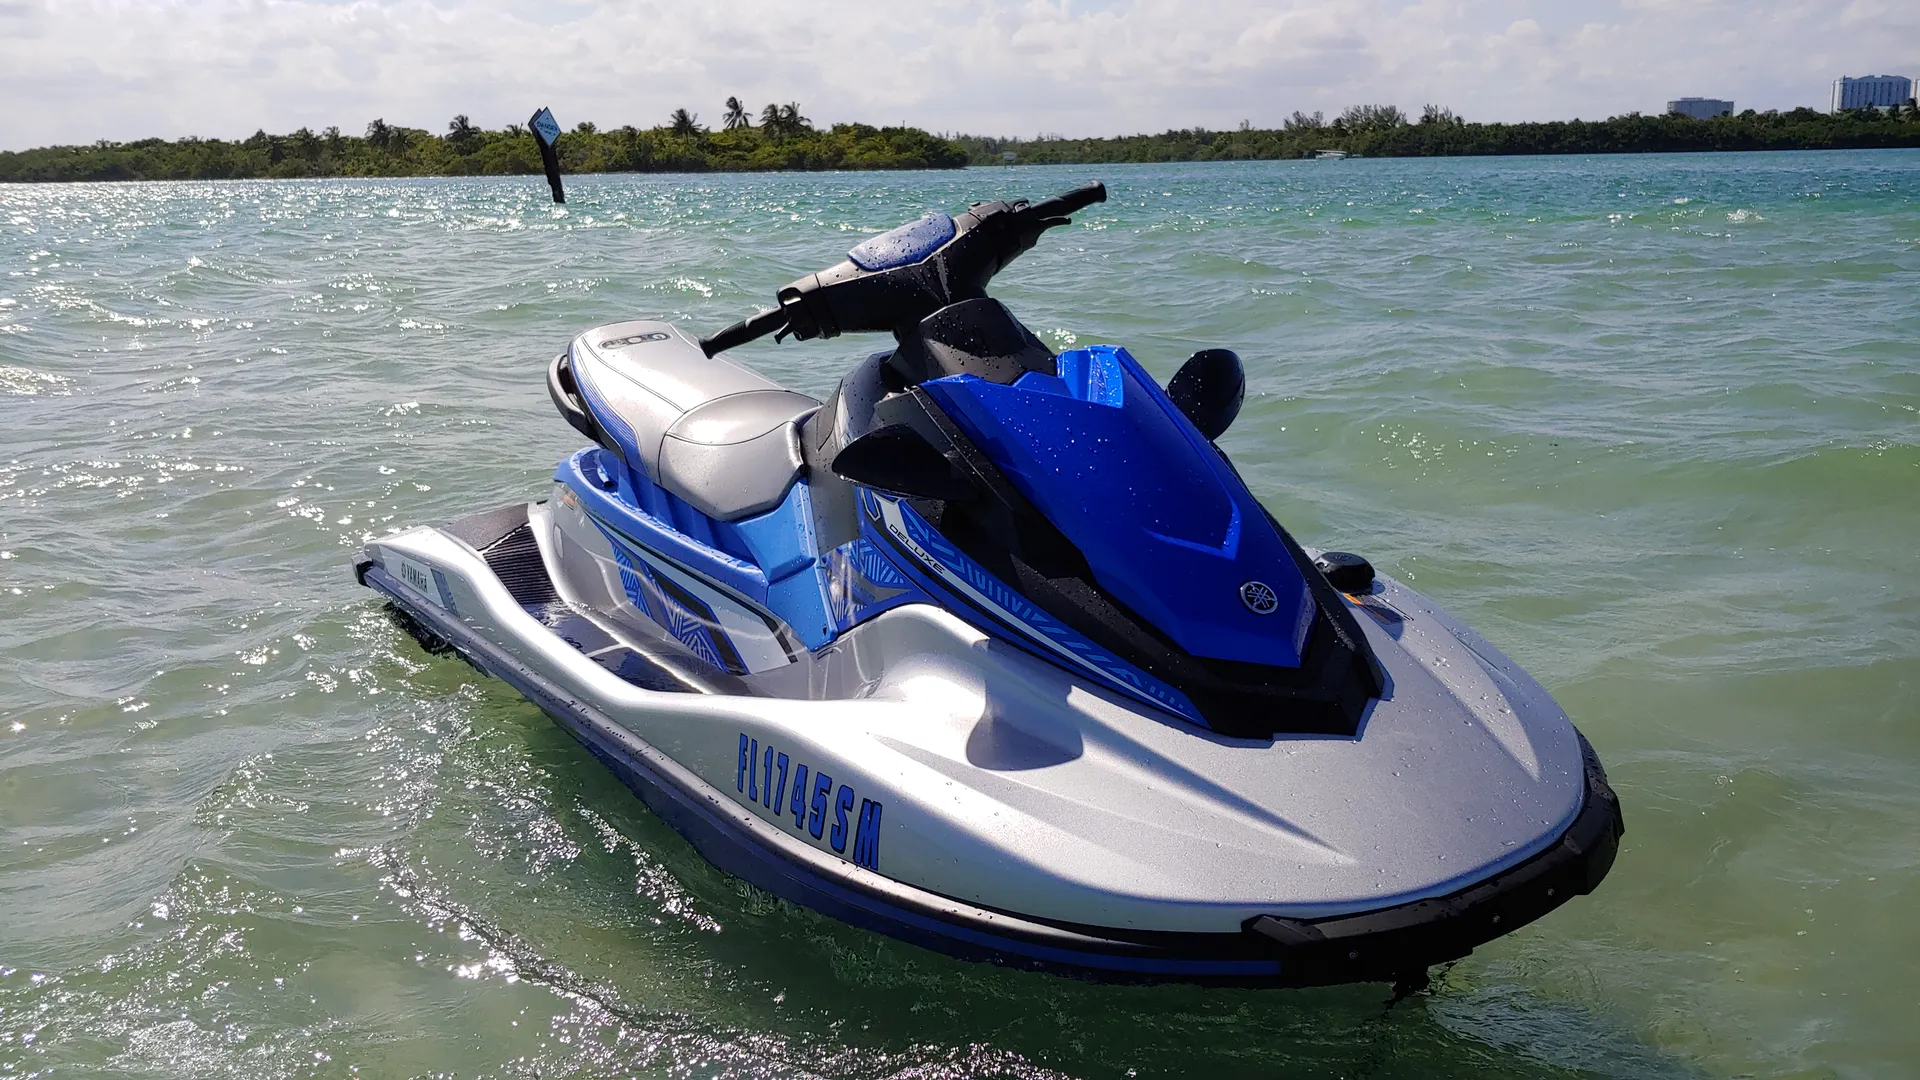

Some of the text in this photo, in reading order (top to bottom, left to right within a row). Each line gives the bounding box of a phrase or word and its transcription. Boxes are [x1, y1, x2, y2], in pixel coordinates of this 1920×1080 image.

[889, 524, 945, 574] DELUXE
[406, 564, 427, 593] YAMAHA
[737, 732, 883, 871] FL1745SM
